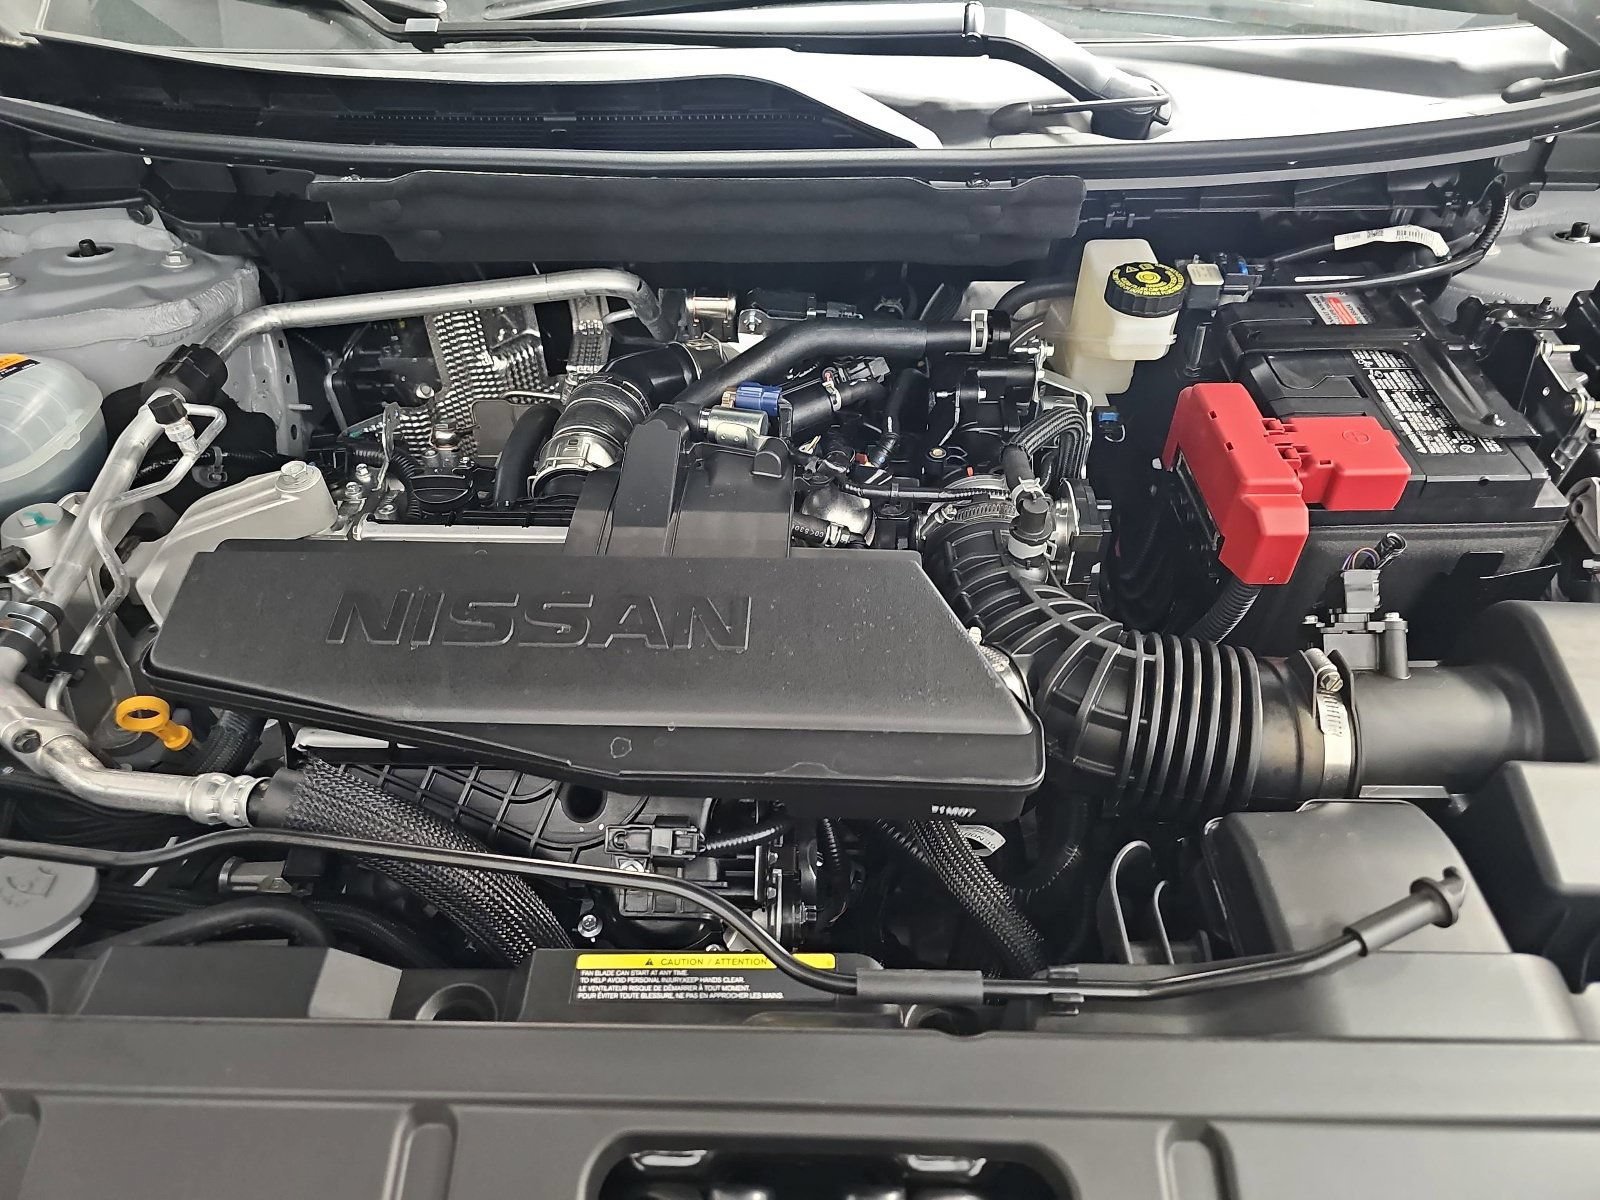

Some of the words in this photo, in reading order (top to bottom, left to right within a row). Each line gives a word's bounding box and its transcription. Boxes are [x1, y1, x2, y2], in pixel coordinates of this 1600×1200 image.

[325, 591, 752, 651] NISSAN
[660, 958, 704, 966] CAUTION
[714, 958, 767, 966] ATTENTION
